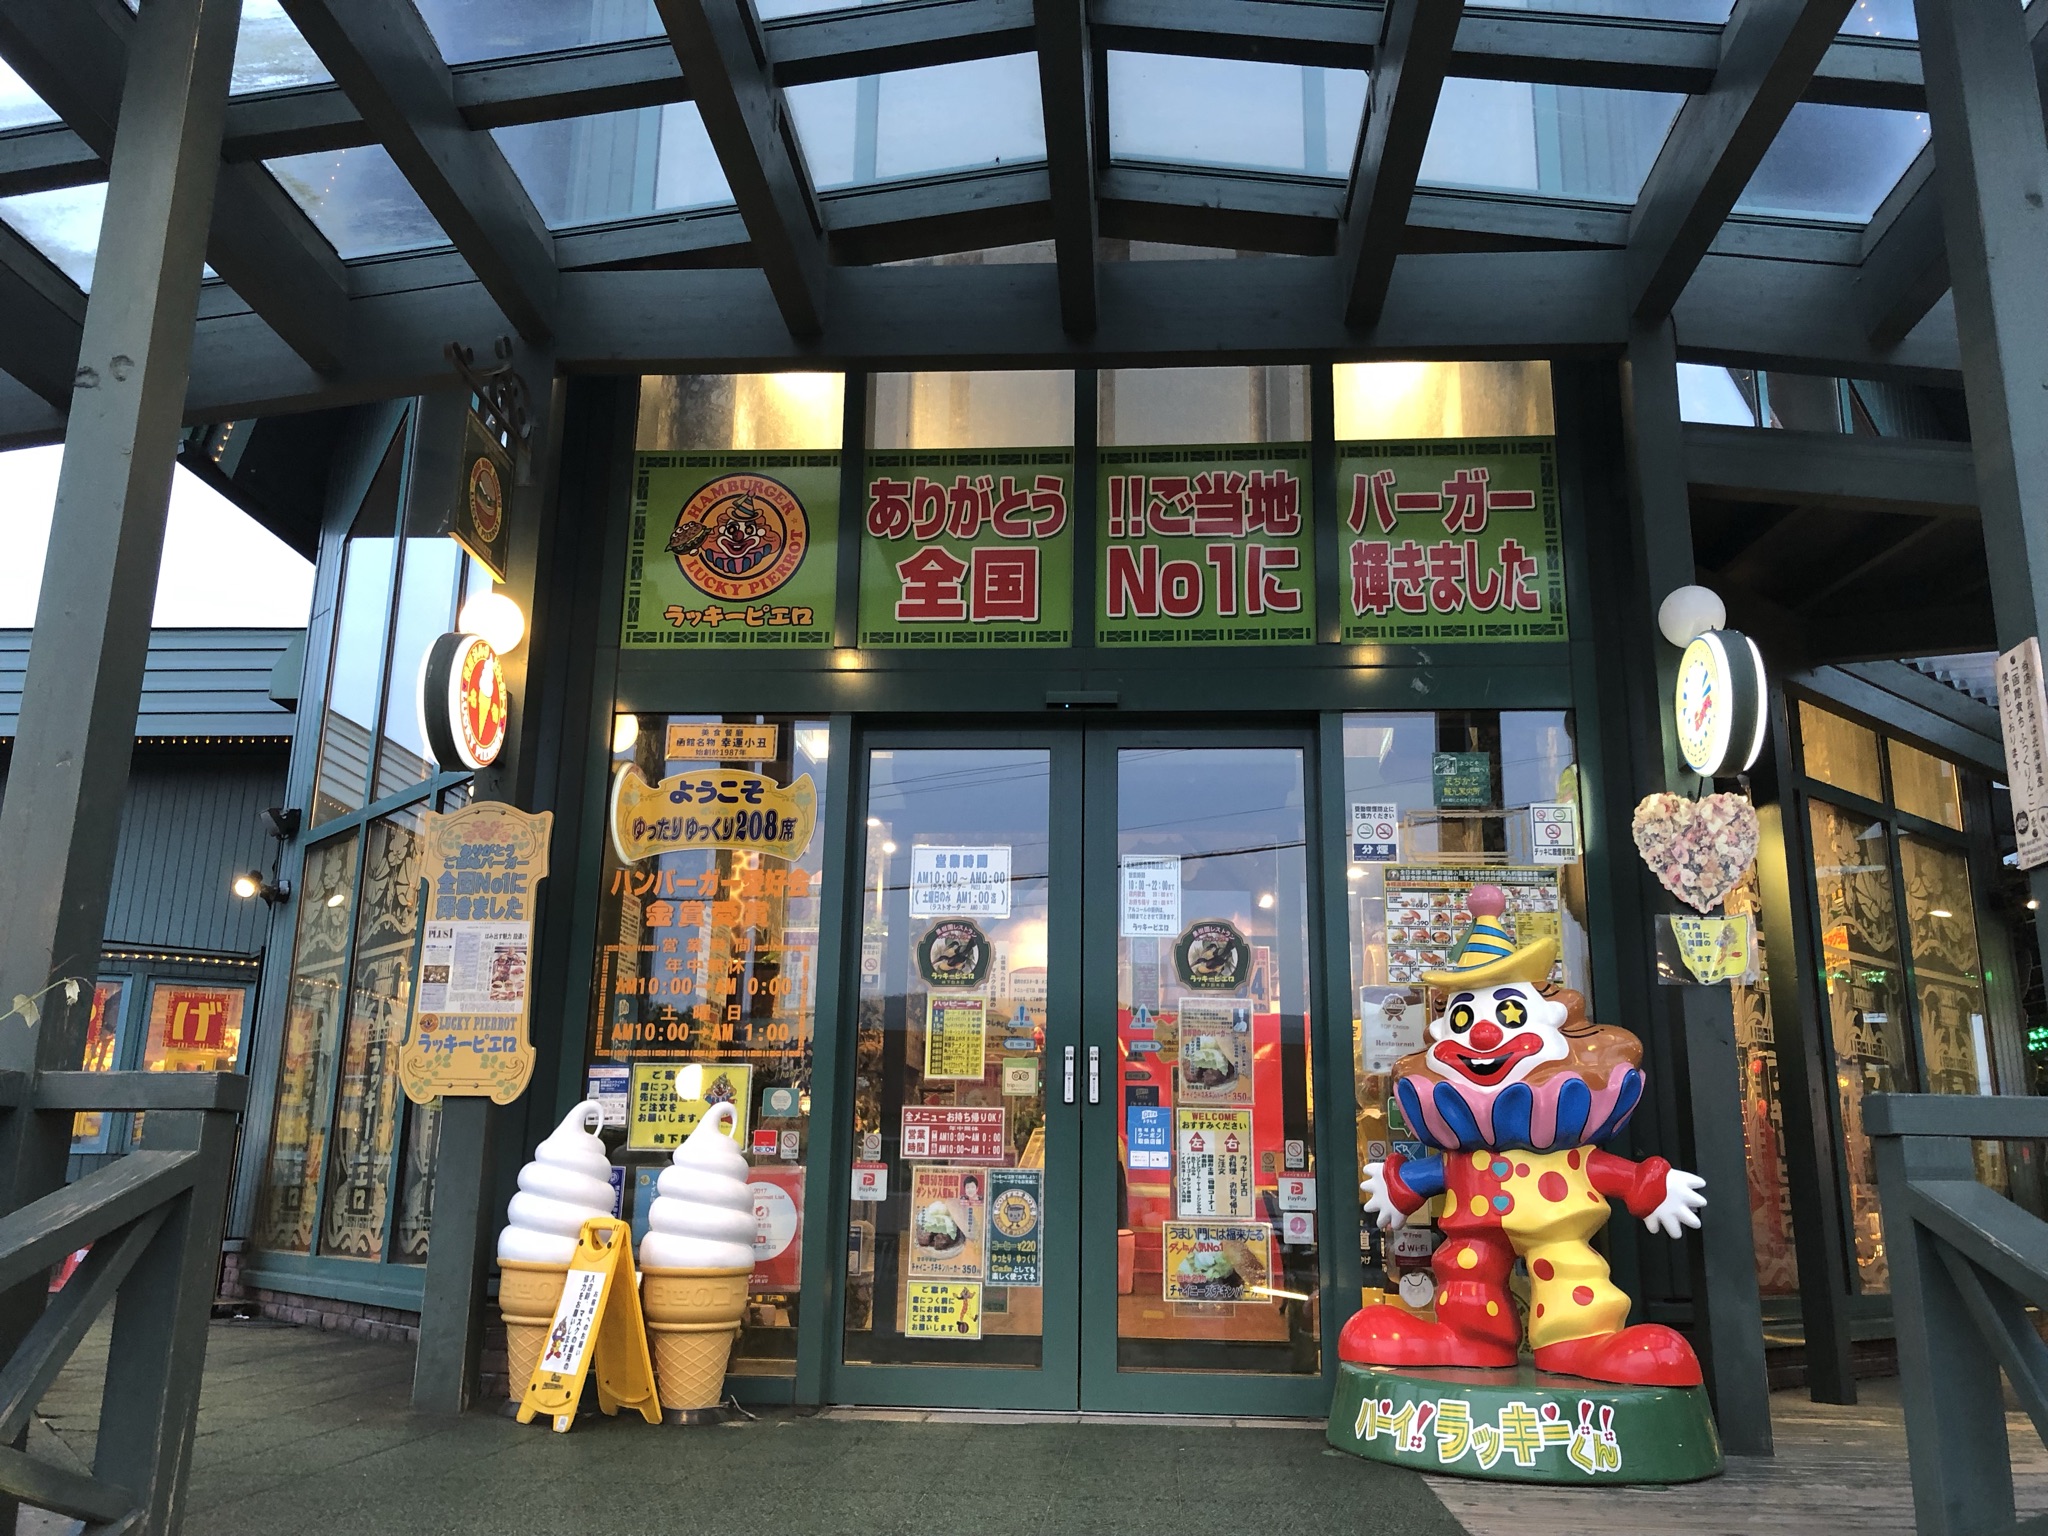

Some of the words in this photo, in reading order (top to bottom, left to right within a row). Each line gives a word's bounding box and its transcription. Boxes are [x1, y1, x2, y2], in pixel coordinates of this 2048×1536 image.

[687, 480, 796, 519] HAMBURGER
[868, 474, 1066, 539] ありがとう
[1107, 470, 1301, 538] !!ご当地
[1347, 467, 1534, 534] バーガー
[686, 559, 743, 596] LUCKY
[748, 529, 803, 595] PIERROT
[895, 546, 1040, 622] 全国
[1106, 543, 1301, 618] No1に
[1350, 539, 1540, 616] 輝きました
[663, 604, 814, 627] ラッキーピエロ
[1445, 776, 1479, 786] まちかど
[669, 780, 765, 804] ようこそ
[460, 844, 515, 857] ありがとう
[1361, 844, 1389, 855] 分煙
[443, 856, 529, 870] ご当地バーガー
[437, 870, 527, 895] 全国No1に
[611, 868, 811, 897] ハンバーガー愛好会
[436, 896, 523, 920] 輝きました
[1132, 923, 1169, 931] ラッキーピエロ
[665, 958, 746, 974] 年中無休
[931, 972, 975, 980] ラッキーピエロ
[1190, 975, 1235, 983] ラッキーピエロ
[661, 1004, 742, 1021] 土曜日
[171, 1001, 223, 1042] げ
[438, 1016, 471, 1031] LUCKY
[473, 1017, 517, 1031] PIERROT
[418, 1033, 517, 1054] ラッキーピエロ
[652, 1070, 677, 1080] ご案
[640, 1082, 677, 1092] 席につく
[639, 1103, 677, 1112] ご注文を
[637, 1113, 701, 1123] お願いします。
[1192, 1112, 1238, 1121] WELCOME
[352, 1047, 382, 1210] ラッキーピエロ
[1182, 1121, 1247, 1130] おすすみください
[907, 1129, 926, 1140] 営業
[907, 1142, 926, 1153] 時間
[1192, 1138, 1203, 1148] 左
[1227, 1139, 1238, 1149] 右
[1218, 1155, 1226, 1175] ご注文
[1240, 1155, 1248, 1197] ラッキーピエロ
[1169, 1227, 1265, 1243] うまい門には福来たる
[992, 1241, 1016, 1251] コーヒー
[1407, 1244, 1428, 1252] Wi-Fi
[922, 1286, 949, 1294] ご案内
[912, 1314, 940, 1322] ご注文を
